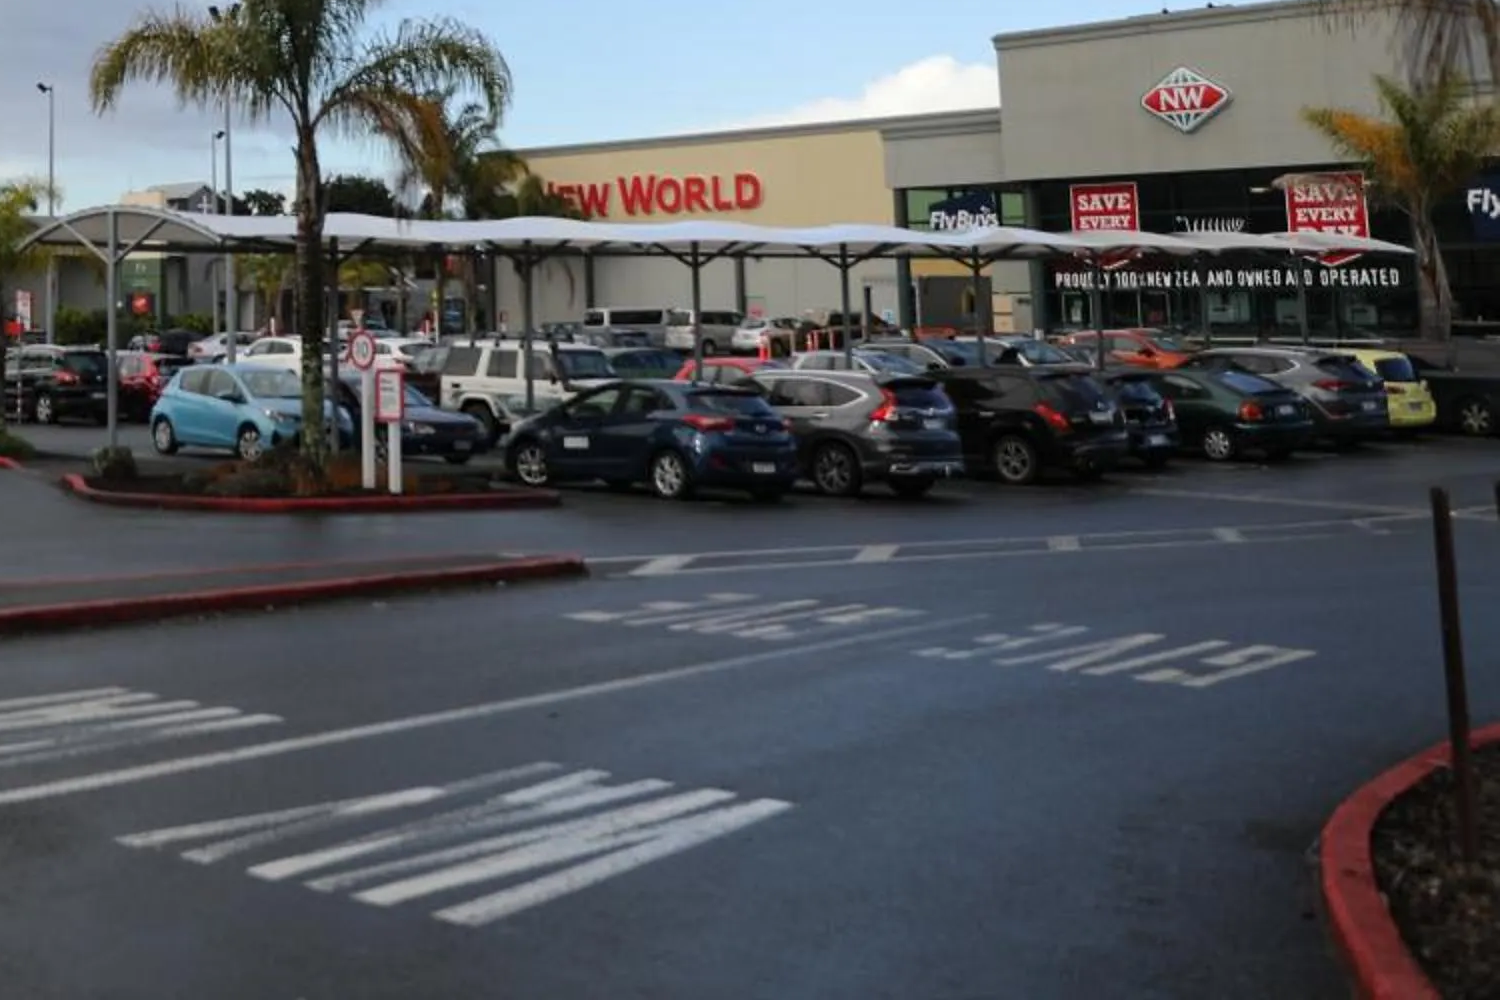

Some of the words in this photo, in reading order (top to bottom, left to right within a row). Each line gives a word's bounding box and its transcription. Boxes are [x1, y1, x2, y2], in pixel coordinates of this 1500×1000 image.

[1159, 85, 1205, 111] NW
[617, 172, 763, 217] WORLD
[1077, 192, 1131, 212] SAVE
[1292, 182, 1357, 203] SAVE
[1079, 214, 1131, 230] EVERY
[1295, 205, 1357, 222] EVERY
[1147, 271, 1171, 288] NEW
[1175, 269, 1233, 288] ZEAAND
[1237, 269, 1281, 288] OWNED
[1319, 268, 1400, 287] OPERATED
[910, 622, 1317, 688] GIVE
